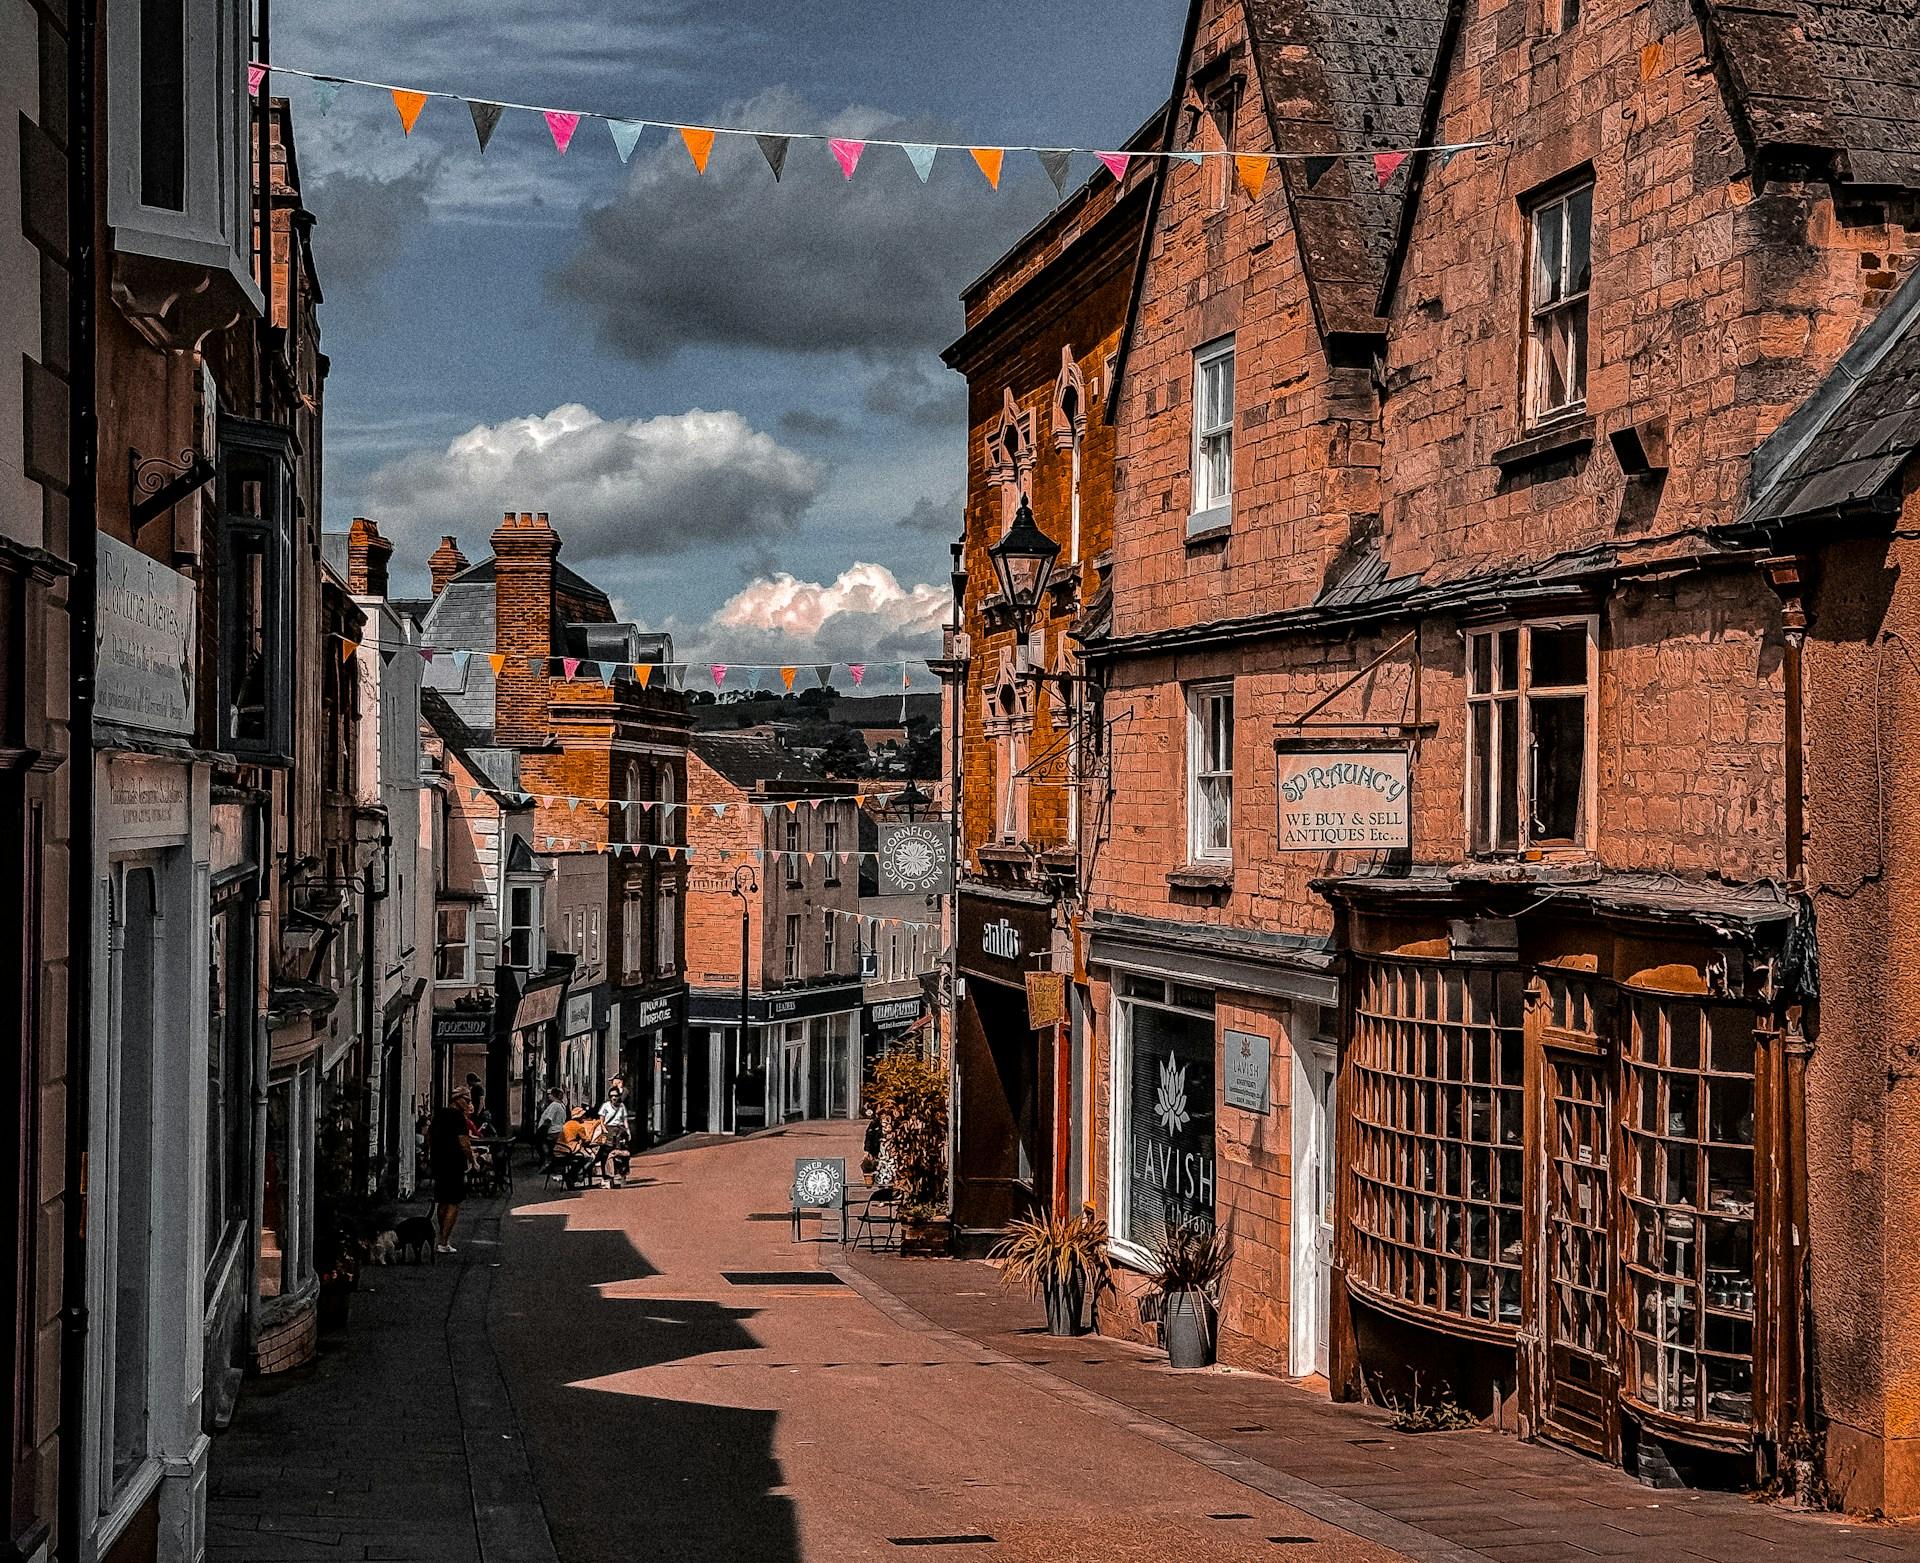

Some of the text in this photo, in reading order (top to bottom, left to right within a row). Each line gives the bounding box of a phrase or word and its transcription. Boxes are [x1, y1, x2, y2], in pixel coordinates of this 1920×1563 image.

[1282, 763, 1406, 803] SPRAUNCY
[1286, 812, 1403, 827] WE BUY & SELL
[1285, 828, 1404, 844] ANTIQUES Etc...
[883, 826, 947, 892] CORNFLOWER AND CALICO
[436, 1020, 486, 1037] BOOKSHOP
[1233, 1059, 1259, 1079] LAVISH
[796, 1161, 841, 1205] CORNFLOWER AND CALICO
[1133, 1134, 1213, 1208] LAVISH
